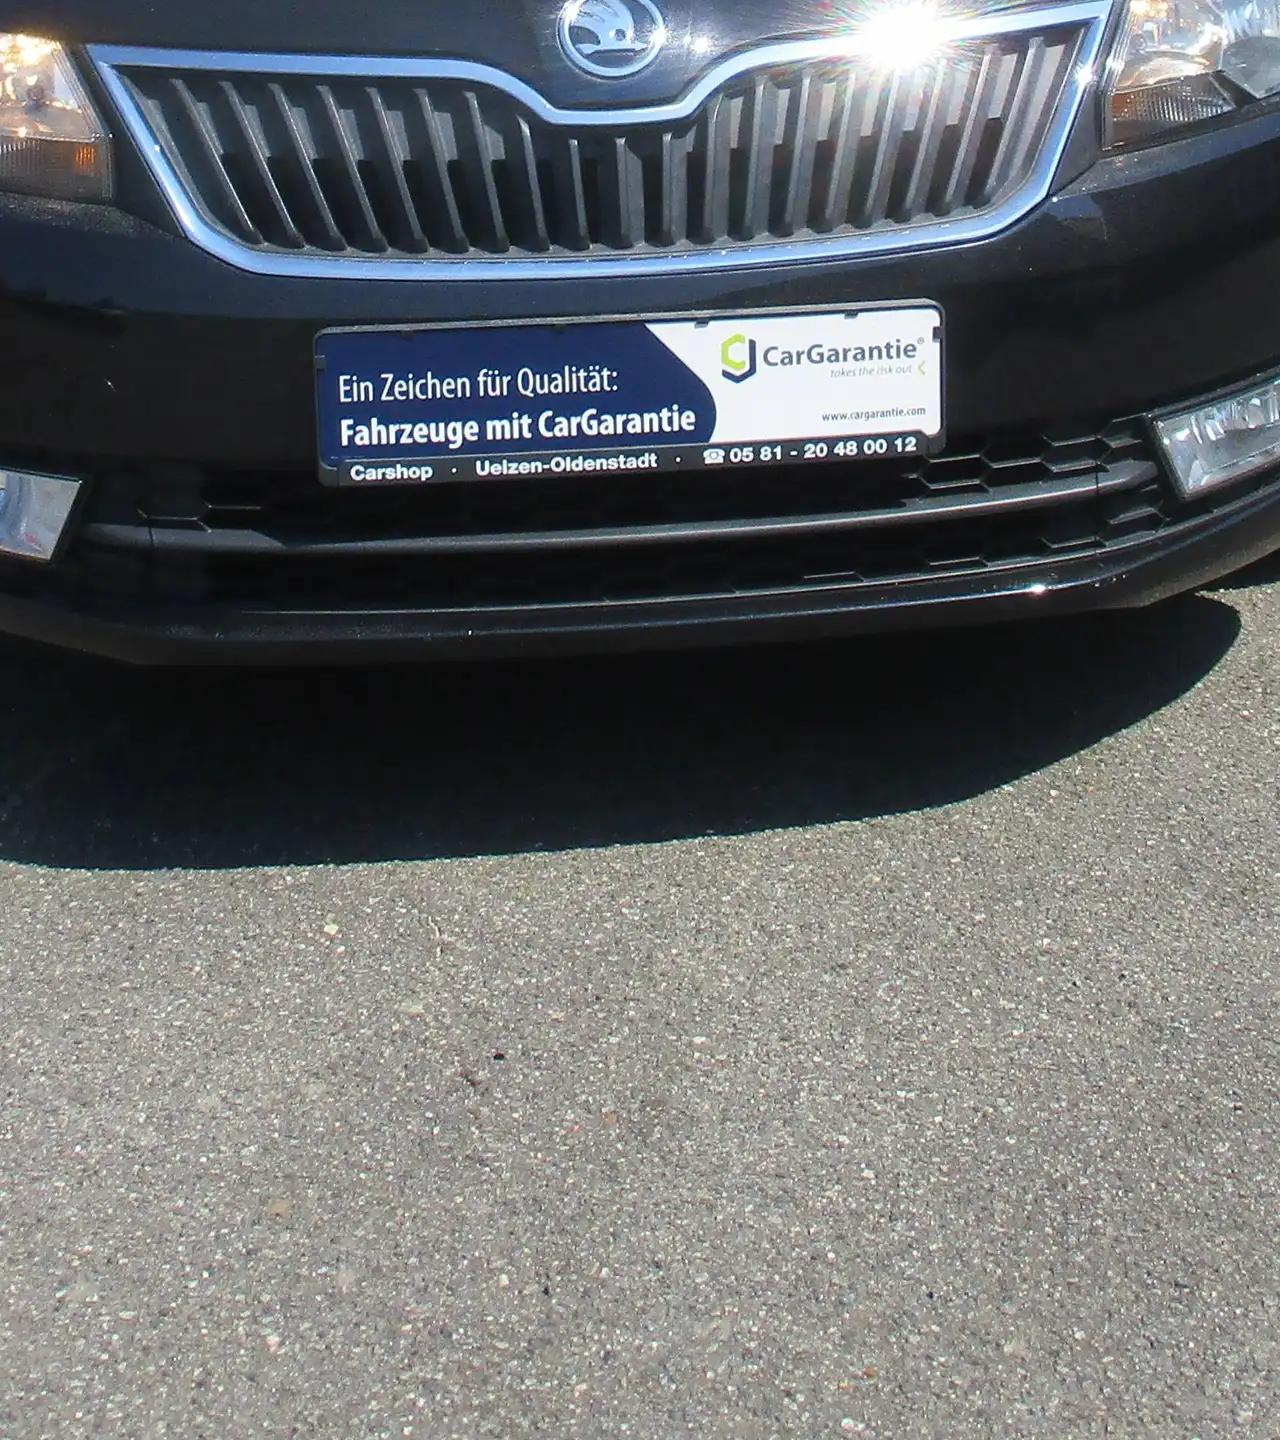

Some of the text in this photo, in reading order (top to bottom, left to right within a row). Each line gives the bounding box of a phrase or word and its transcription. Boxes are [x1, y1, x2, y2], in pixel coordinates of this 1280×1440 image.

[338, 364, 619, 403] Ein Zeichen für Qualität:
[858, 366, 875, 377] the
[340, 403, 697, 449] Fahrzeuge mit CarGarantie
[821, 406, 927, 423] www.cargarantie.com
[349, 463, 433, 482] Carshop
[475, 452, 658, 477] Uelzen-Oldenstadt
[729, 446, 754, 463] 05
[759, 445, 783, 462] 81
[803, 442, 826, 459] 20
[833, 440, 859, 457] 48
[863, 438, 888, 455] 00
[893, 436, 918, 453] 12
